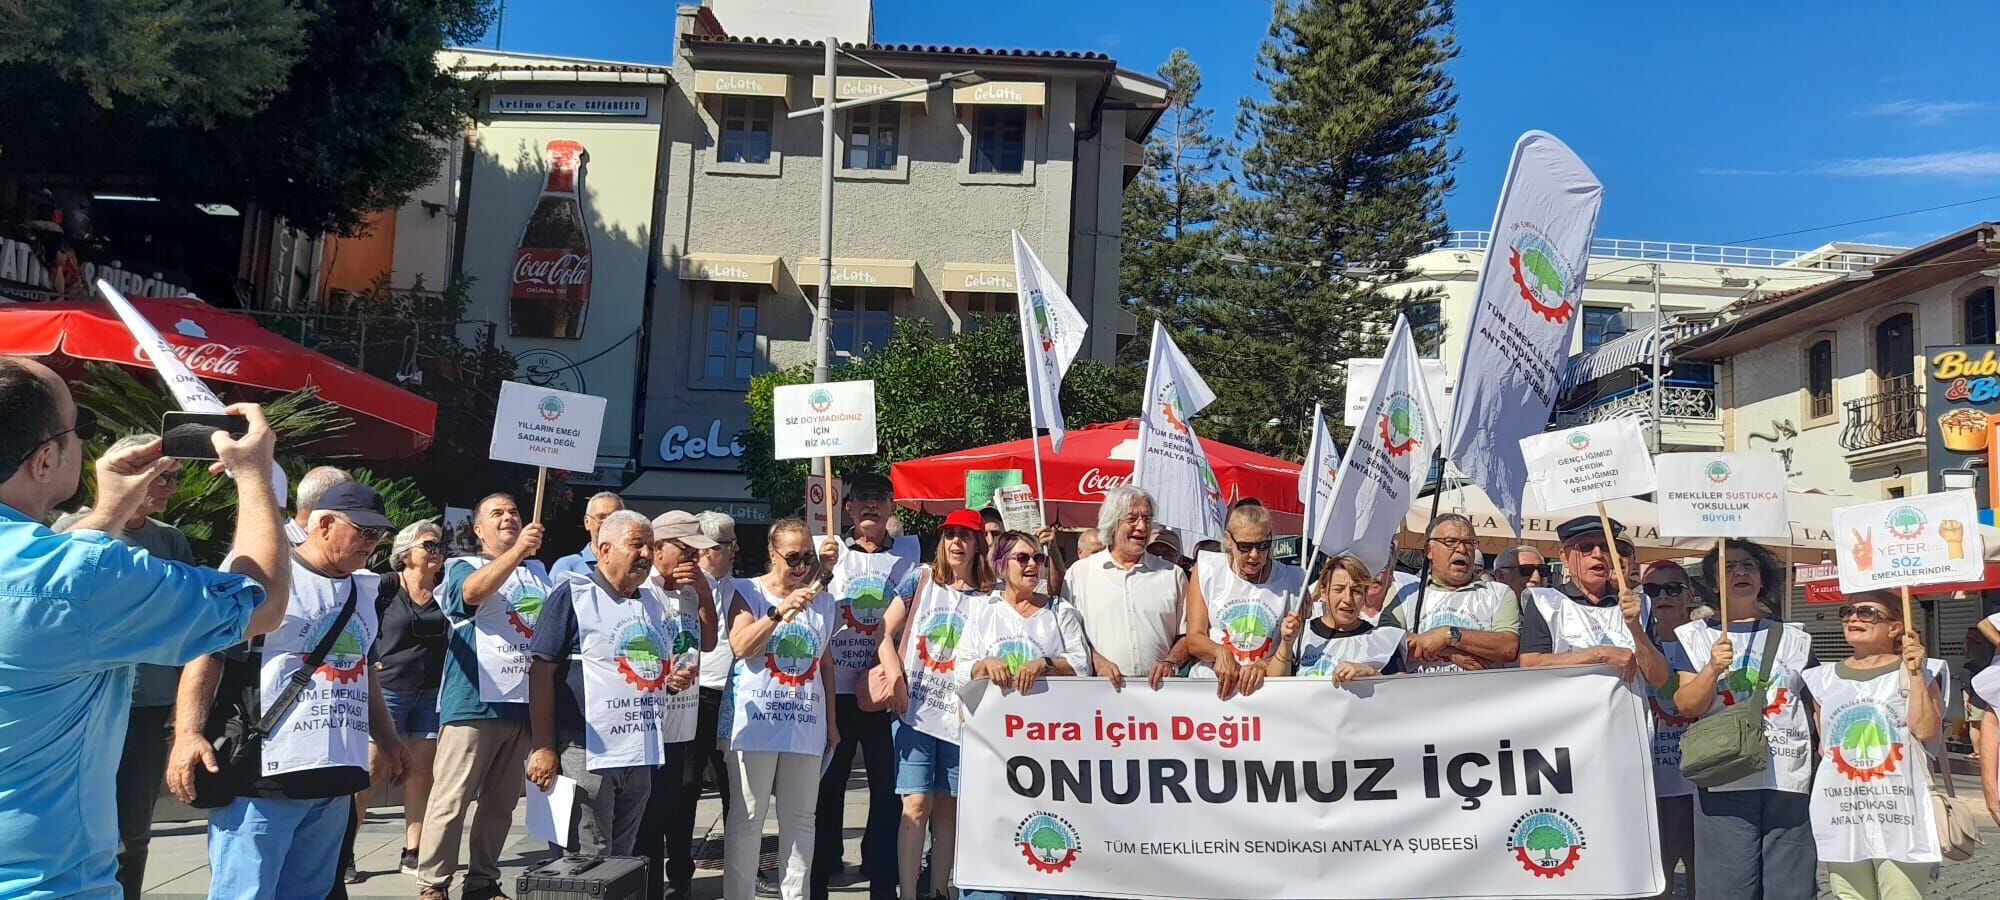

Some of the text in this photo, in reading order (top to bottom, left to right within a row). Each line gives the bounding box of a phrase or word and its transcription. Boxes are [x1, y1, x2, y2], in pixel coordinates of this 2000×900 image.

[716, 78, 763, 93] GeLatte
[975, 87, 1022, 101] GeLatte
[499, 99, 542, 109] Artimo
[548, 100, 576, 110] Cafe
[513, 253, 590, 284] Coca-Cola
[700, 265, 748, 280] GeLatte
[965, 274, 1014, 289] GeLatte
[1529, 287, 1546, 304] 2017
[1487, 301, 1561, 386] TÜM EMEKLİLERİN
[134, 343, 247, 375] Ca-Cola
[1500, 329, 1545, 382] SENDİKASI
[1480, 327, 1551, 408] ANTALYA ŞUBESİ
[1933, 350, 2000, 380] Bub
[1945, 378, 1969, 400] &
[785, 412, 862, 425] SİZ DOYMADIĞINIZ
[518, 421, 580, 438] YILLARIN EMEĞİ
[813, 426, 830, 436] İÇİN
[1151, 428, 1167, 438] TÜM
[518, 433, 577, 448] SADAKA DEĞİL
[805, 438, 818, 447] BİZ
[1358, 438, 1375, 453] TÜM
[529, 444, 559, 455] HAKTIR
[1148, 447, 1185, 462] ANTALYA
[1558, 448, 1613, 466] GENÇLİĞİMİZİ
[1350, 459, 1385, 486] ANTALYA
[1573, 461, 1604, 473] VERDİK
[1079, 468, 1133, 496] Coca-
[1571, 481, 1612, 494] VERMEYİZ
[1668, 491, 1779, 501] EMEKLİLER SUSTUKÇA
[714, 503, 766, 521] GLatte
[1691, 502, 1750, 510] YOKSULLUK
[1468, 514, 1498, 529] LA
[1702, 513, 1736, 522] BÜYÜR
[1803, 528, 1832, 541] LA
[1891, 556, 1921, 569] SÖZ
[497, 644, 517, 653] TÜM
[842, 649, 874, 658] SENDİK
[501, 666, 529, 675] ANTAL
[752, 689, 772, 699] TÜM
[311, 703, 363, 716] SENDİKASI
[606, 697, 630, 709] TÜM
[765, 701, 812, 712] SENDİKASI
[927, 697, 957, 715] ŞUBESİ
[752, 713, 796, 722] ANTALYA
[610, 723, 657, 736] ANTALYA
[1005, 710, 1261, 748] Para İçin Değil
[267, 761, 279, 771] 19
[1006, 739, 1574, 811] ONURUMUZ İÇİN
[1824, 785, 1914, 797] TÜM EMEKLİLERİN
[1840, 800, 1897, 811] SENDİKASI
[1831, 813, 1914, 826] ANTALYA ŞUBESİ
[1104, 834, 1479, 855] TÜM EMEKLİLERİN SENDİKASI ANTALYA ŞUBEESİ
